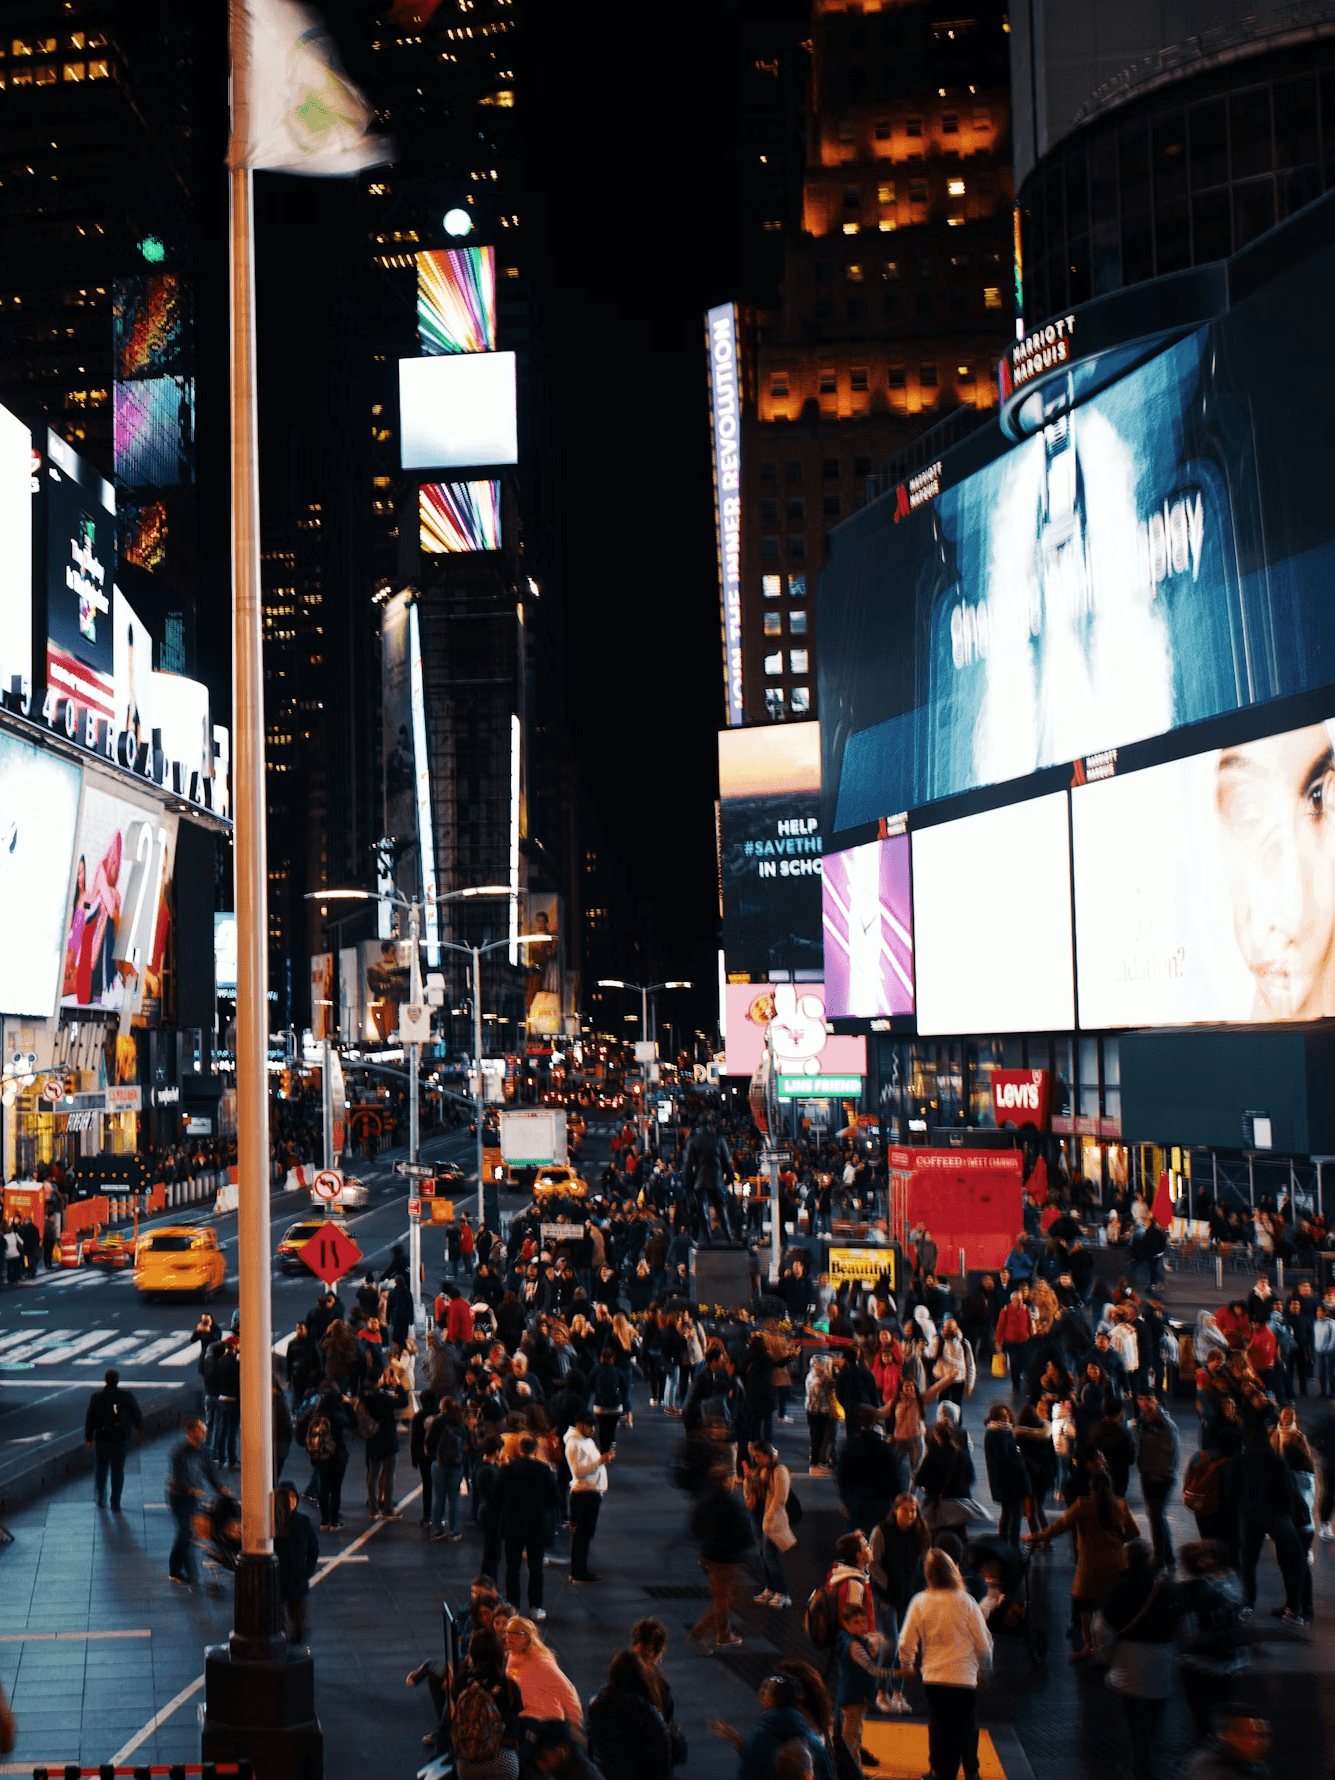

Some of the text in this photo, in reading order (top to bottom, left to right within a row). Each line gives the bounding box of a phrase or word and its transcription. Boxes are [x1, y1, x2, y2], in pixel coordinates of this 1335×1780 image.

[1013, 315, 1076, 366] MARRIOTT
[1013, 341, 1067, 387] MARQUIS
[713, 318, 741, 490] REVOLUTION
[722, 496, 742, 583] INNER
[778, 818, 818, 836] HELP
[759, 857, 823, 878] IN SCHO
[783, 1079, 814, 1093] LINE
[915, 1155, 962, 1169] COFFEED
[831, 1261, 891, 1275] Beautiful
